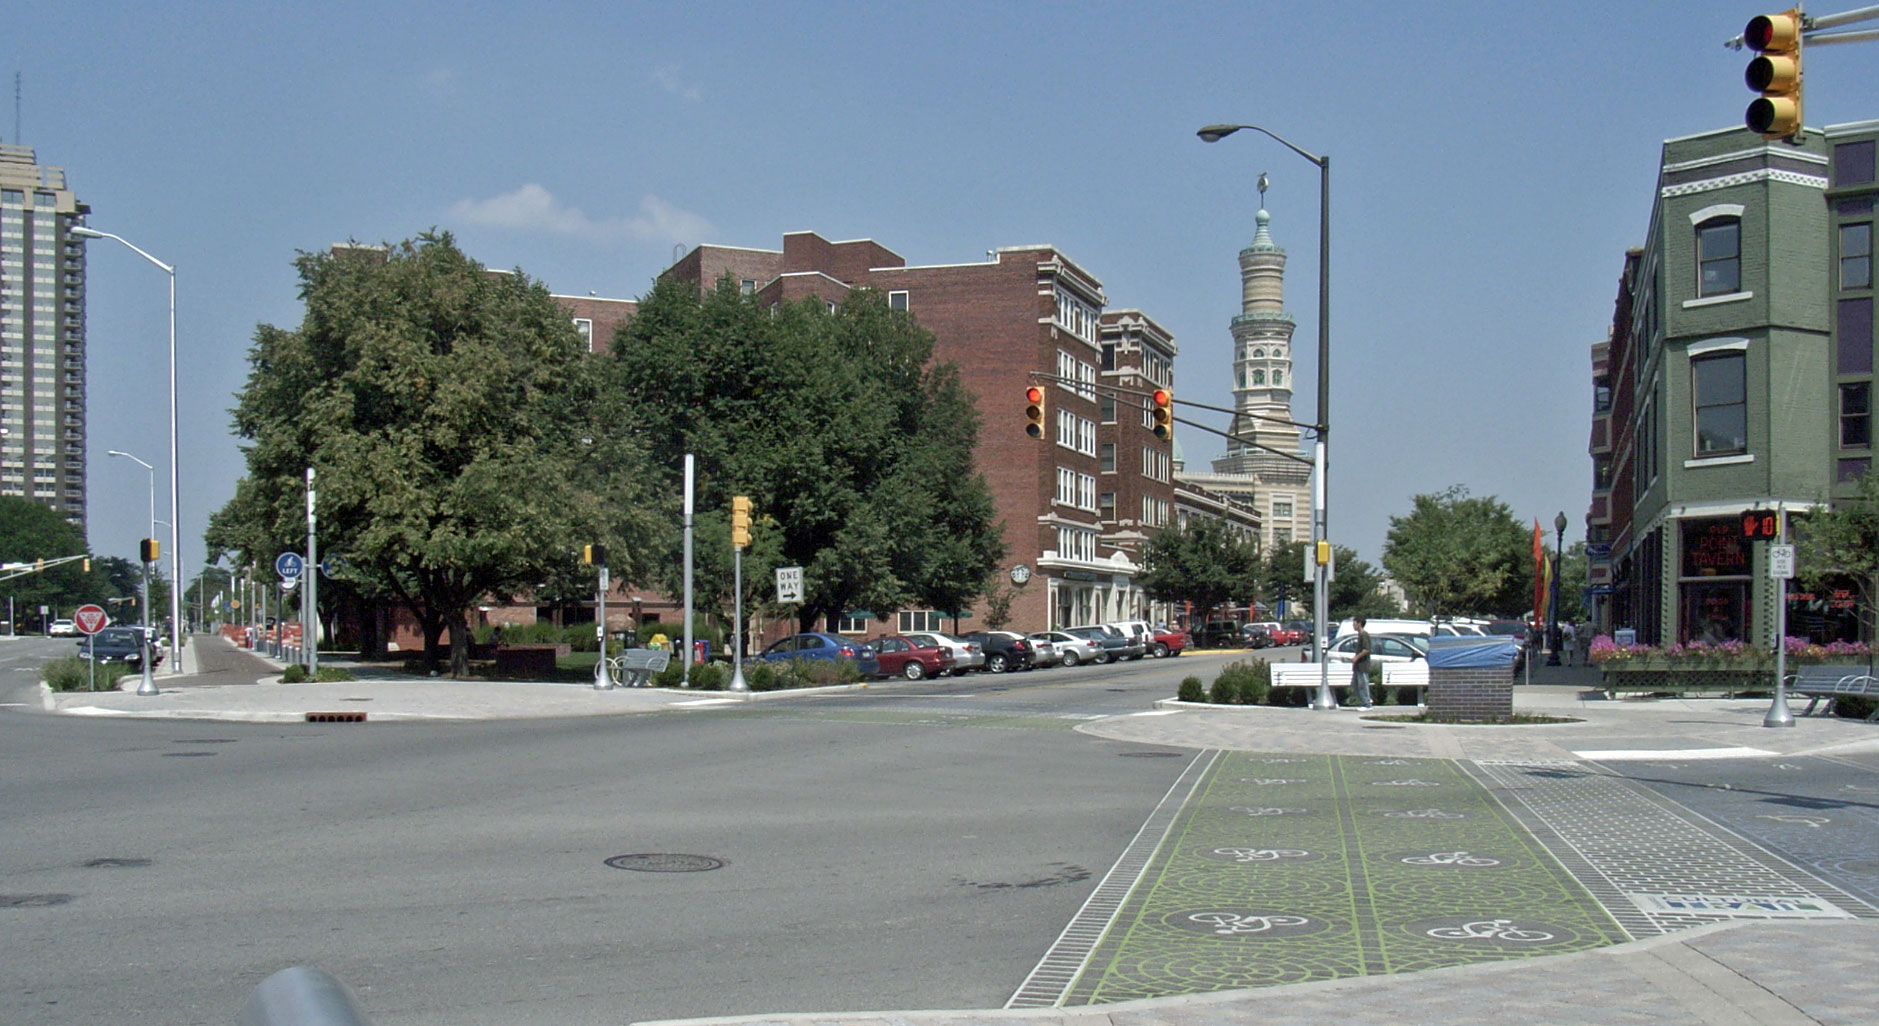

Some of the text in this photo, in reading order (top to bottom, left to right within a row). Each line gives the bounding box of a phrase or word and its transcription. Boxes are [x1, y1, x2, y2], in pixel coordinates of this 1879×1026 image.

[1691, 551, 1745, 566] TAVERN
[780, 571, 798, 580] ONE
[780, 582, 798, 591] WAY
